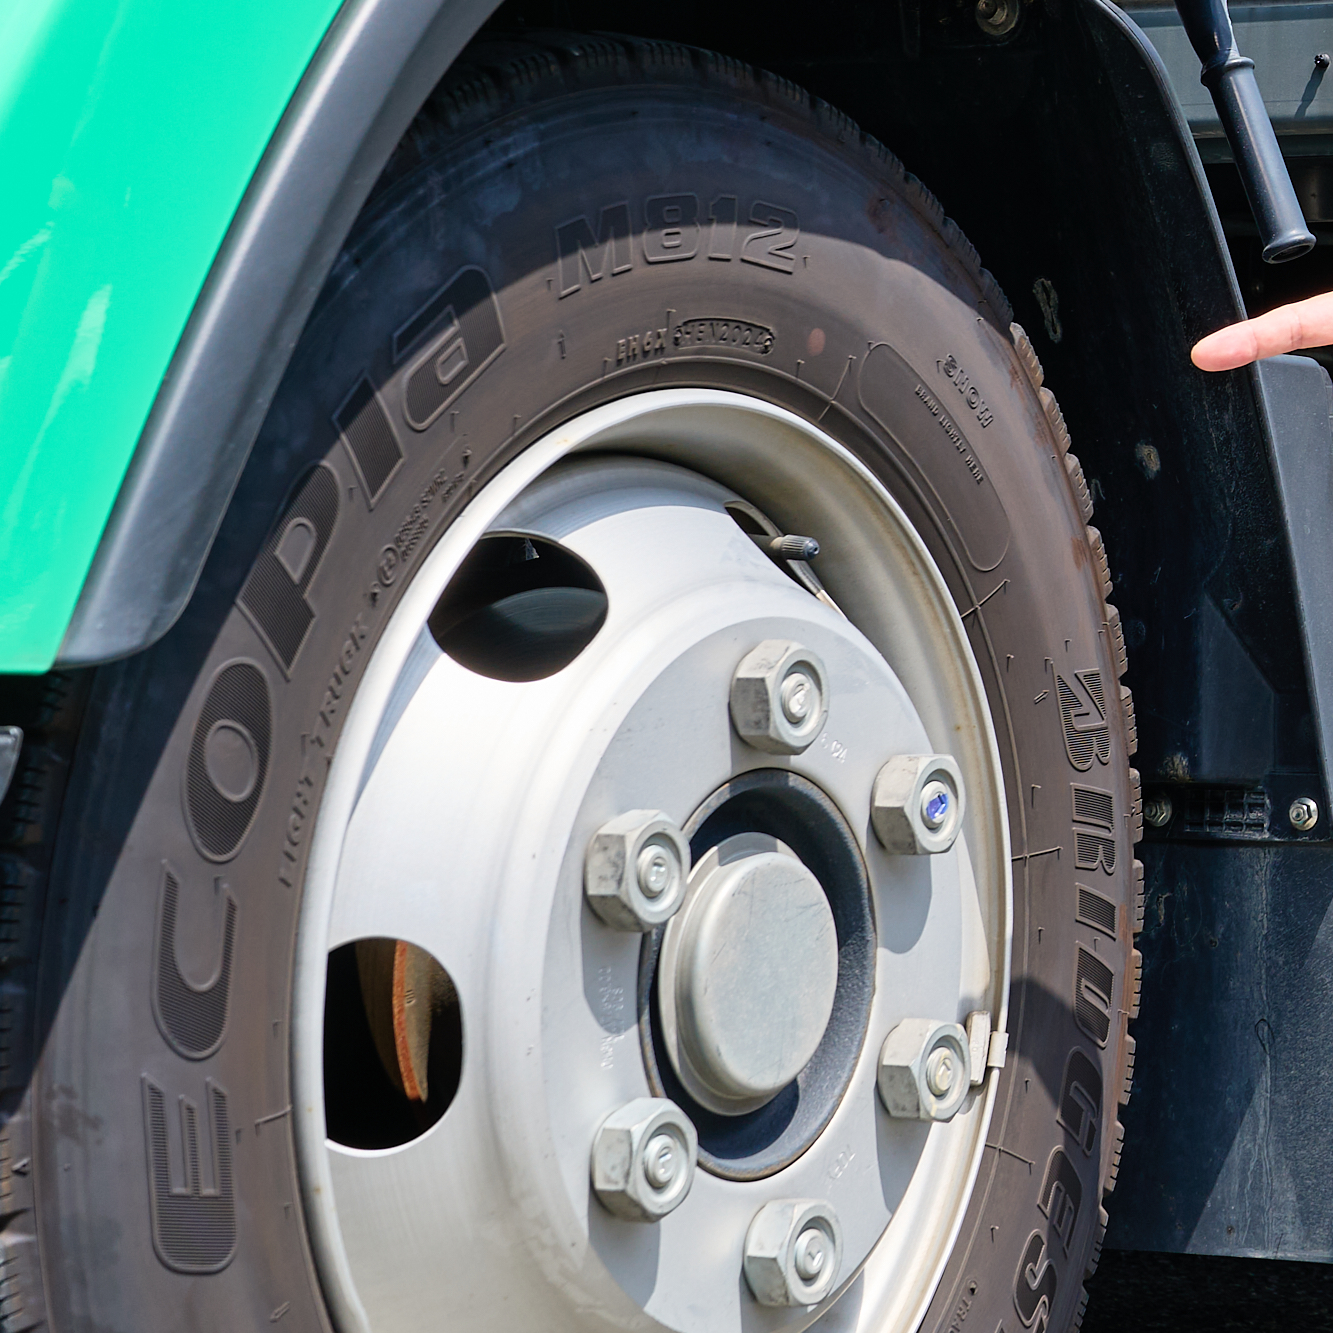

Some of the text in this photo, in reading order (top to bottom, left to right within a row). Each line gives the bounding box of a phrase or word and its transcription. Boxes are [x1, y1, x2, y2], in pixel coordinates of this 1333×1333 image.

[553, 192, 800, 299] M812
[915, 383, 984, 486] BRAND LIGHTLY HERE
[278, 614, 368, 888] LIGHT TRUCK
